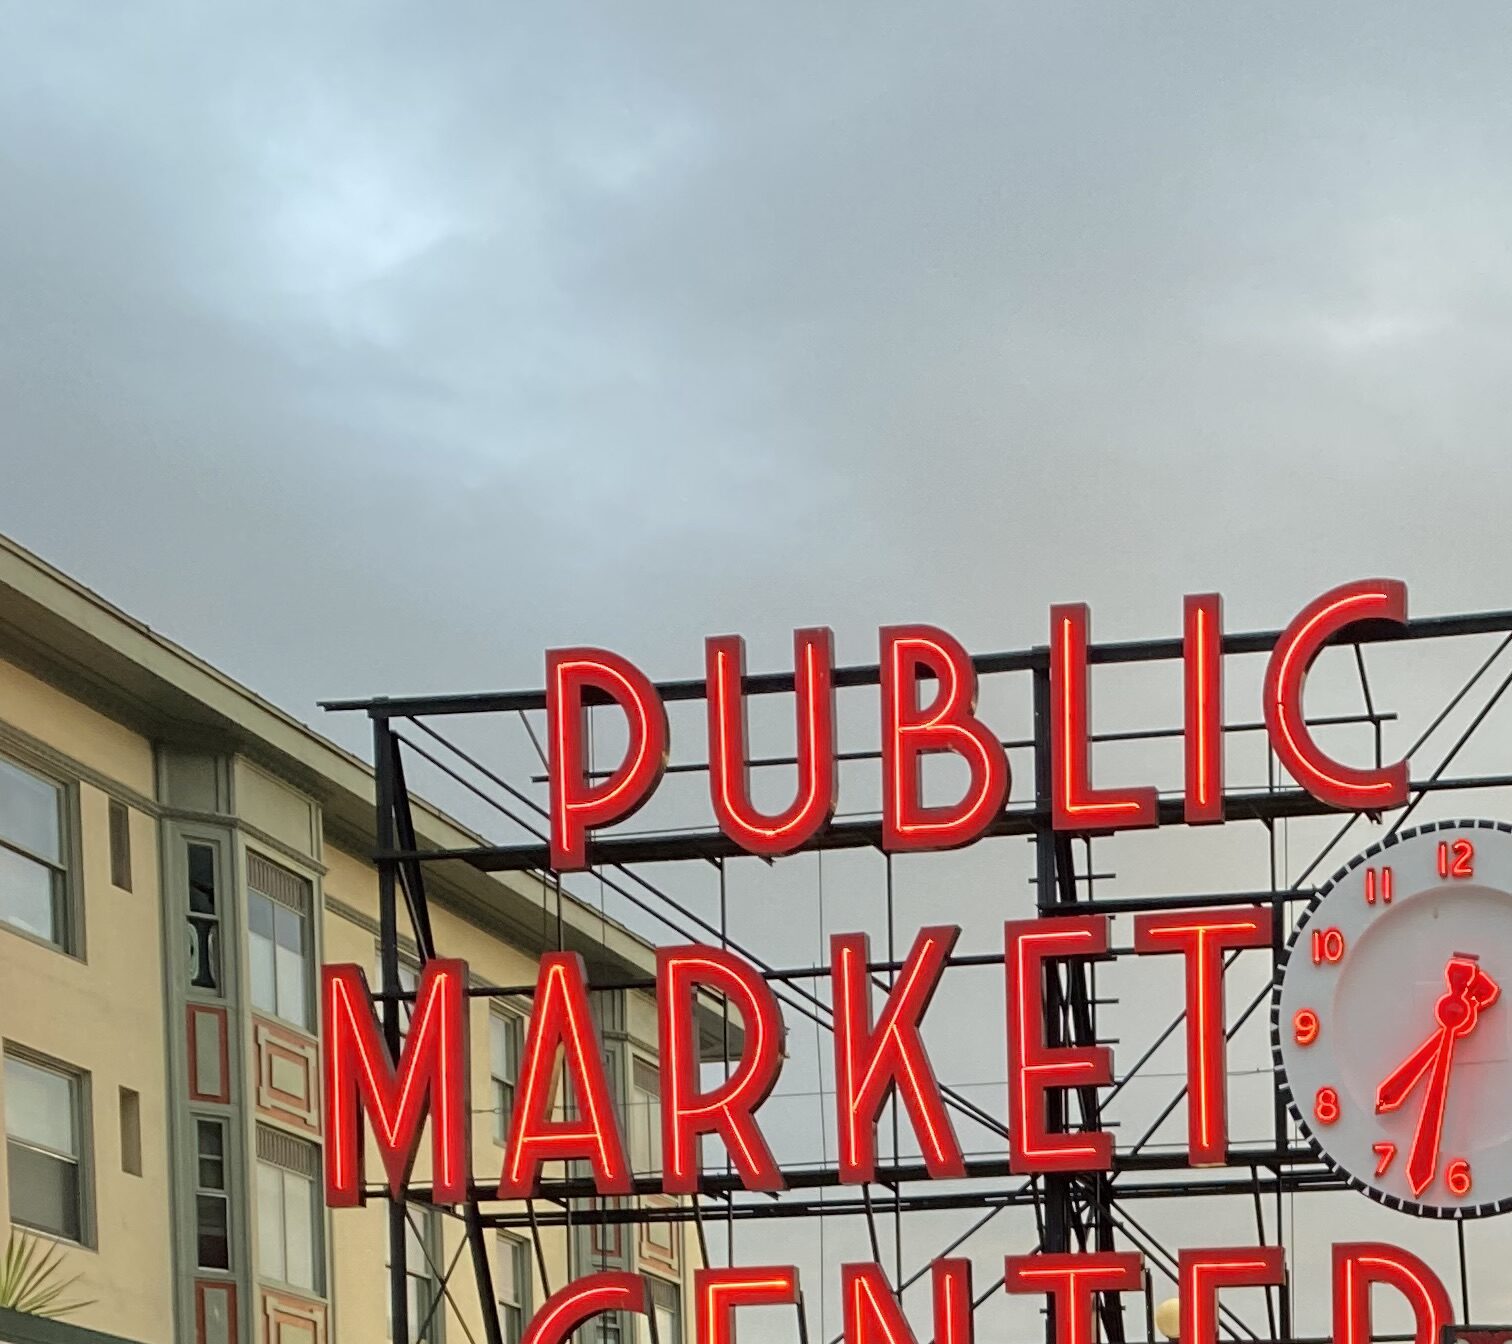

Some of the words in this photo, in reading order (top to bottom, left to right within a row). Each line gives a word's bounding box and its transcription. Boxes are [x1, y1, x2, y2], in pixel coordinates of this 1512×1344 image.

[545, 578, 1409, 872] PUBLIC
[1437, 839, 1475, 879] 12
[1365, 866, 1392, 904] 11
[1311, 927, 1345, 966] 10
[1293, 1008, 1320, 1046] 9
[322, 906, 1273, 1207] MARKET
[1313, 1086, 1340, 1124] 8
[1371, 1143, 1397, 1177] 7
[1444, 1159, 1472, 1197] 6
